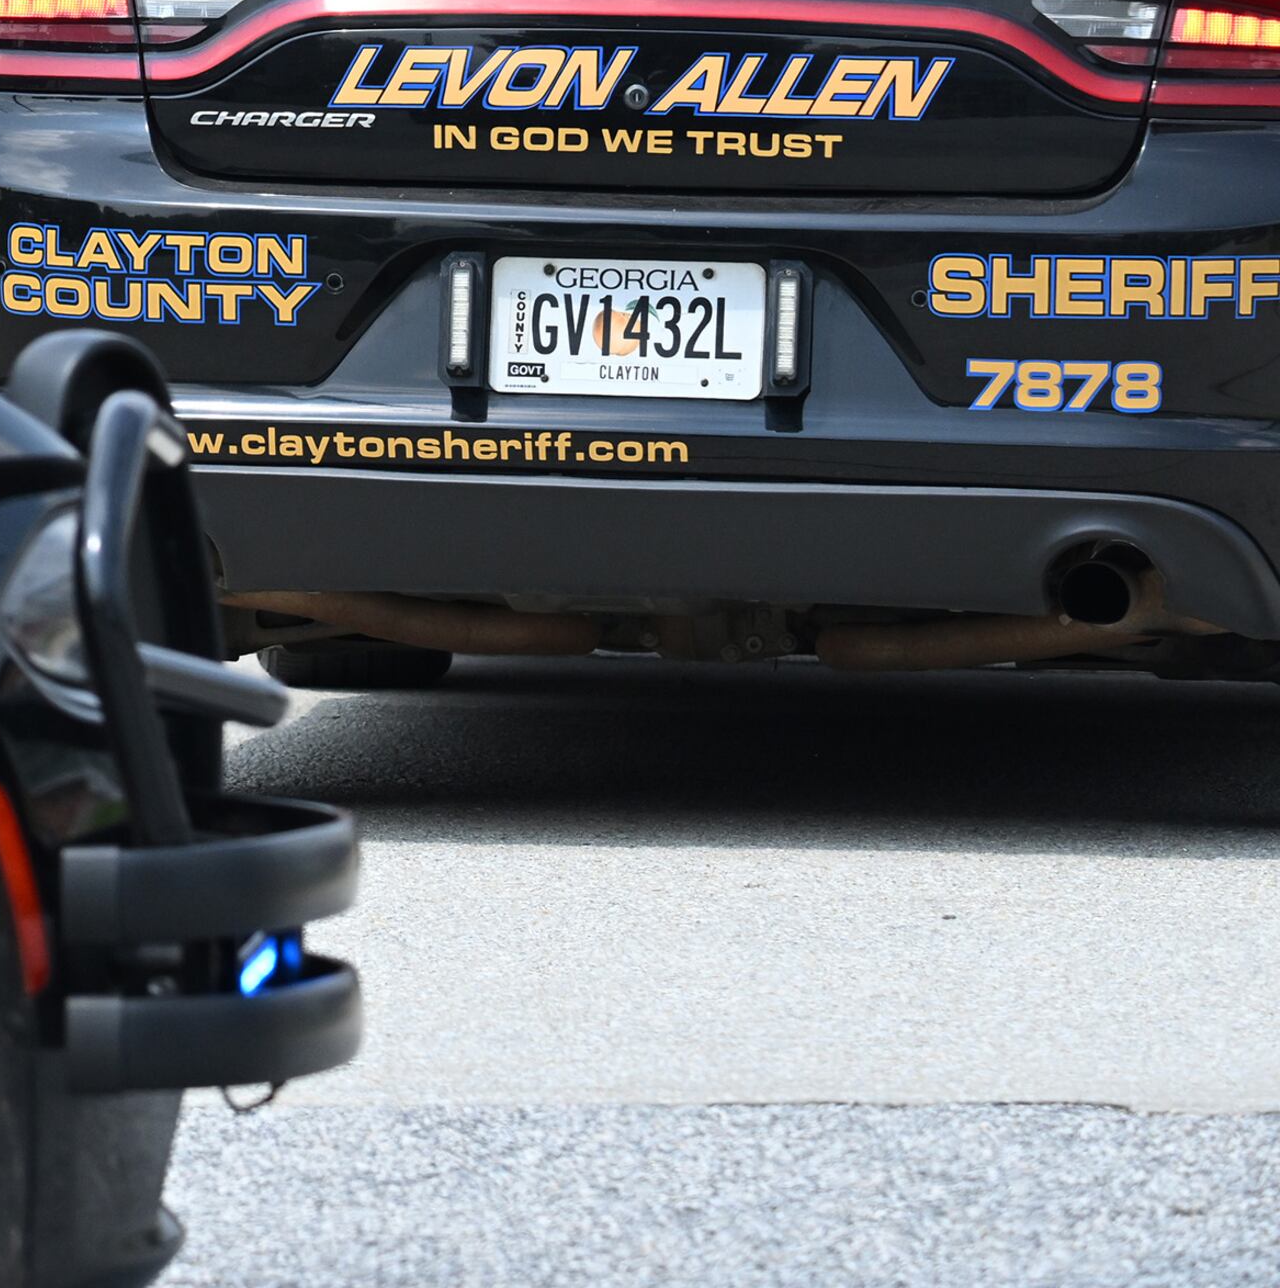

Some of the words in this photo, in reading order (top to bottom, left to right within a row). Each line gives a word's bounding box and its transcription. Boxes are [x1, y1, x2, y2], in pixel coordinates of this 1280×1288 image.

[328, 44, 641, 112] LEVON
[643, 52, 956, 121] ALLEN
[189, 110, 377, 130] CHARGER
[433, 124, 477, 150] IN
[488, 125, 589, 153] GOD
[604, 128, 674, 154] WE
[686, 130, 844, 158] TRUST
[7, 222, 307, 279] CLAYTON
[0, 269, 323, 327] COUNTY
[555, 267, 700, 292] GEORGIA
[928, 252, 1280, 320] SHERIFF
[513, 291, 527, 353] COUNTY
[531, 293, 742, 360] GV1432L
[509, 364, 543, 376] GOVT
[599, 365, 660, 381] CLAYTON
[966, 358, 1162, 413] 7878
